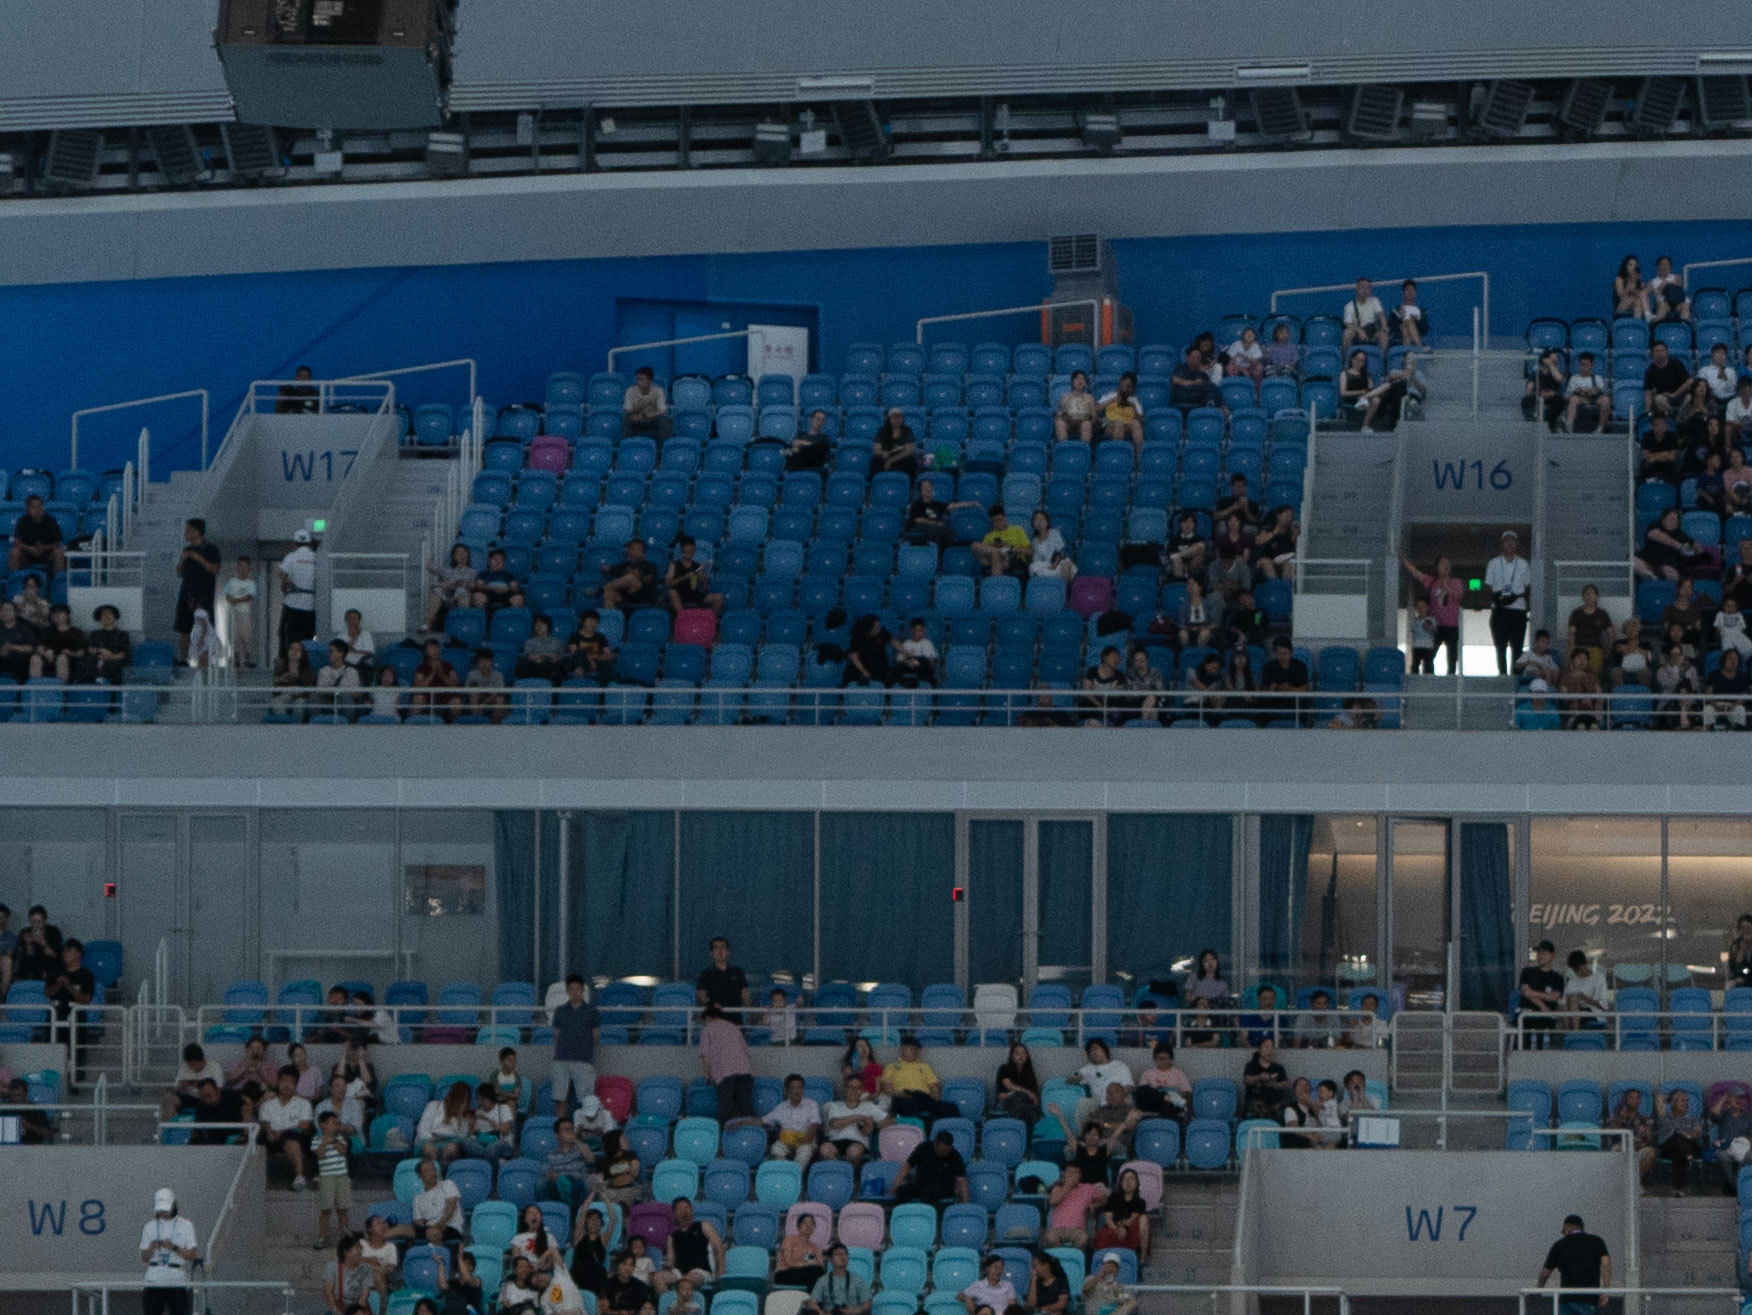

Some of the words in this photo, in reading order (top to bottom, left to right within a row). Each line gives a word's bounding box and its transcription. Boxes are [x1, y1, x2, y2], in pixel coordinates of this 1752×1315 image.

[281, 450, 358, 482] W17
[1433, 459, 1513, 490] W16
[1528, 903, 1601, 929] EIJING
